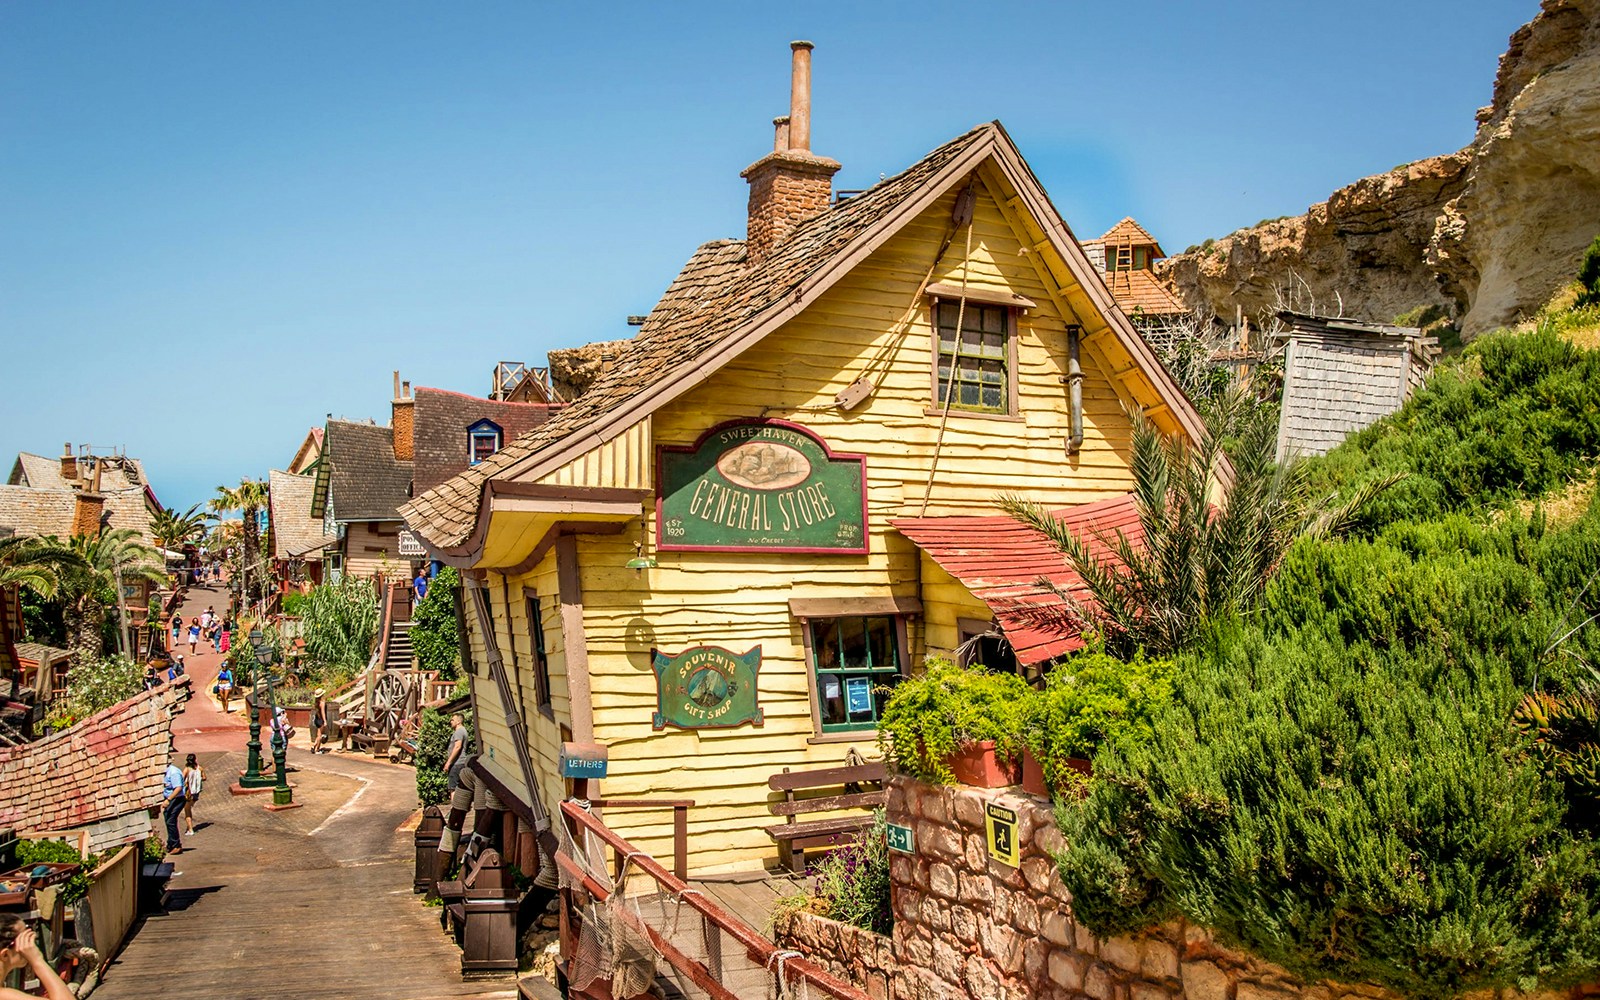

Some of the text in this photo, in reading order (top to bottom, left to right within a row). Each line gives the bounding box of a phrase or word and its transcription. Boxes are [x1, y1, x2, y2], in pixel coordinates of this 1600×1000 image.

[720, 427, 807, 448] SWEETHAVEN
[689, 479, 836, 532] GENERAL STORE
[665, 519, 682, 528] EST
[667, 527, 685, 537] 1920
[680, 653, 736, 679] SOUVENIR
[684, 700, 732, 720] GIFT SHOP
[569, 759, 604, 769] LETTERS
[990, 806, 1013, 822] CAUTION
